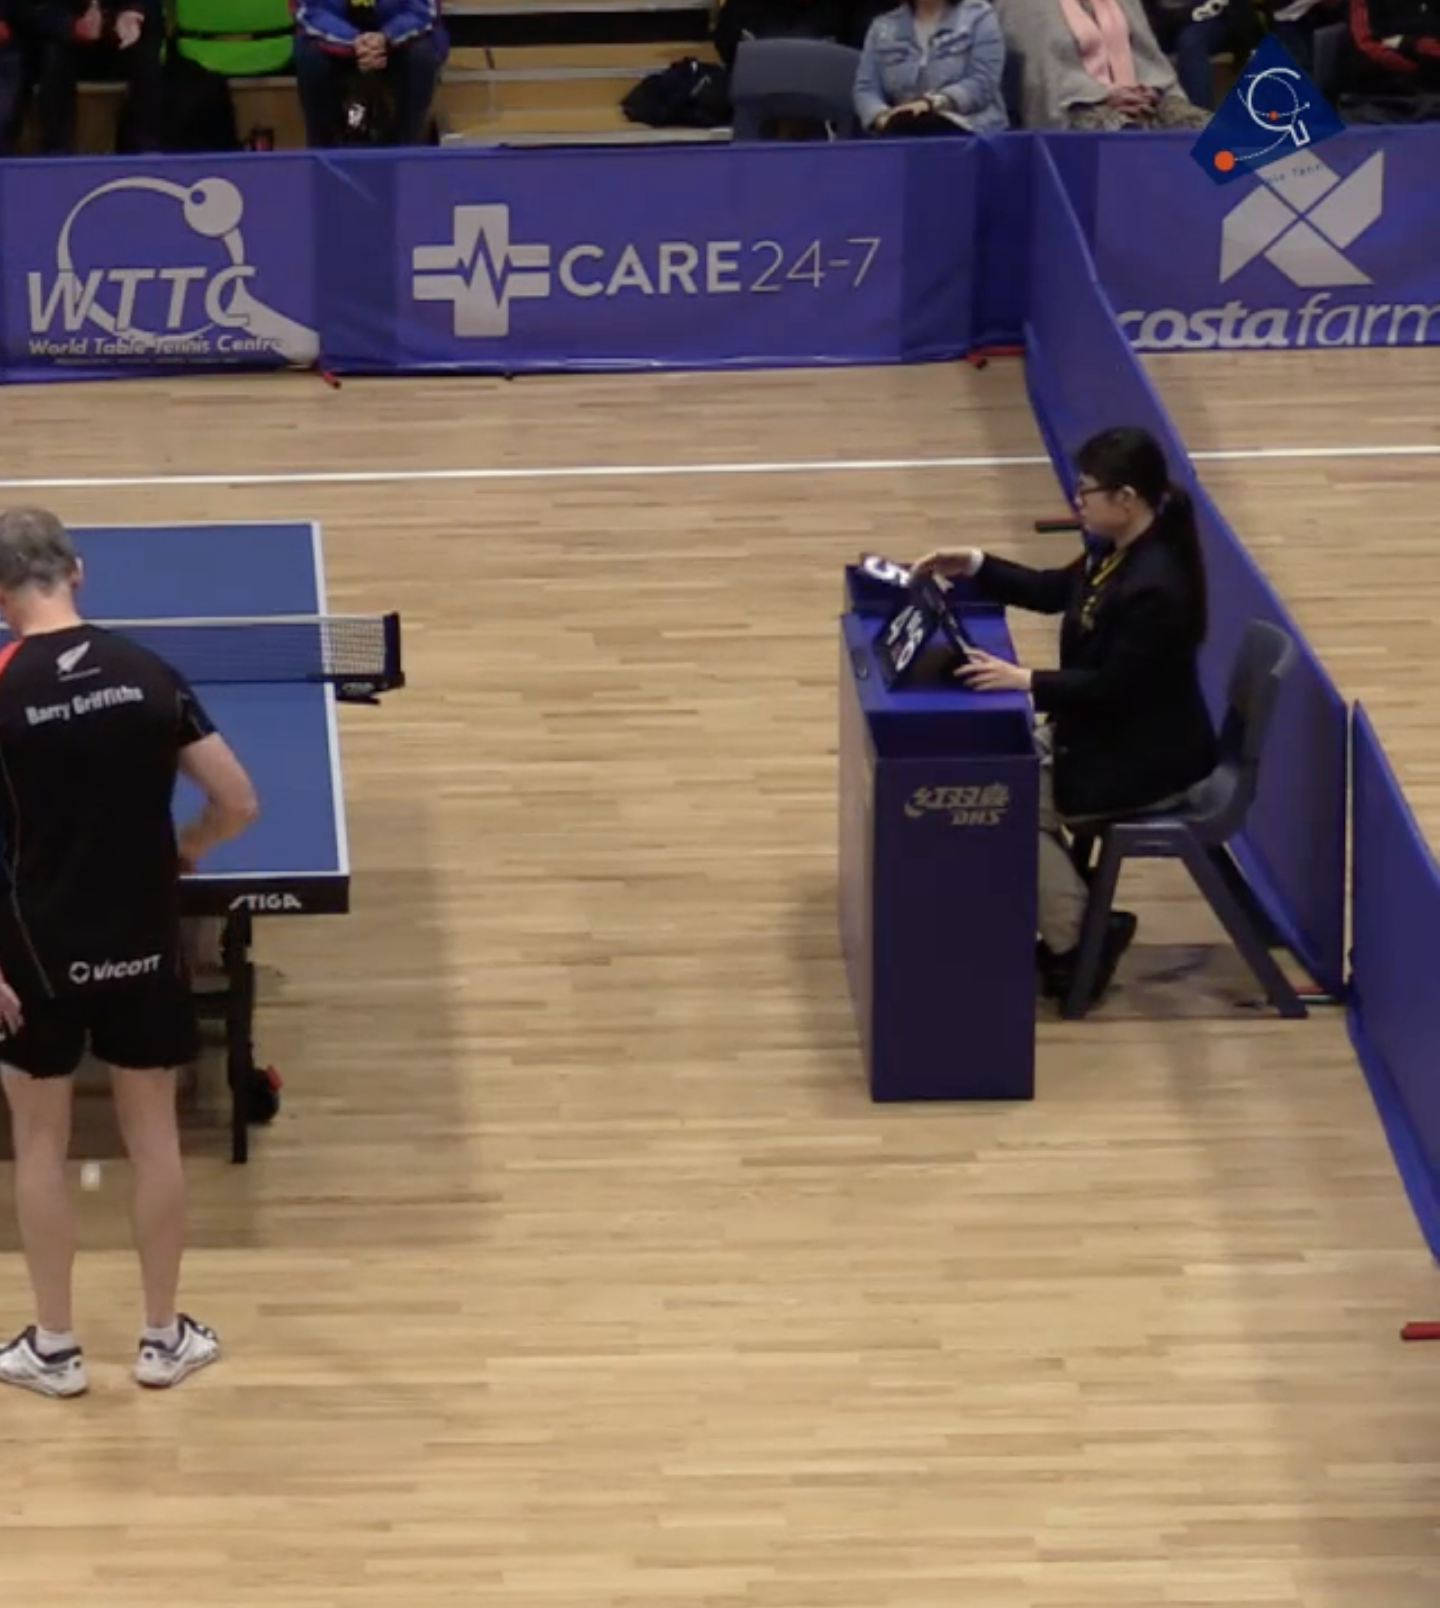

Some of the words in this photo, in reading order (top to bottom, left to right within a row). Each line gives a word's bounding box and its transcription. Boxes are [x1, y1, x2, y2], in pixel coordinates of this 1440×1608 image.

[27, 265, 257, 333] WTTC
[29, 337, 87, 356] World
[94, 336, 145, 355] Table
[154, 334, 211, 354] Tennis
[216, 333, 283, 352] Centre
[24, 702, 71, 726] Barry
[71, 684, 143, 715] Griffiths
[951, 808, 1001, 826] DHS
[229, 893, 303, 911] STIGA
[92, 953, 162, 982] VICOTT
